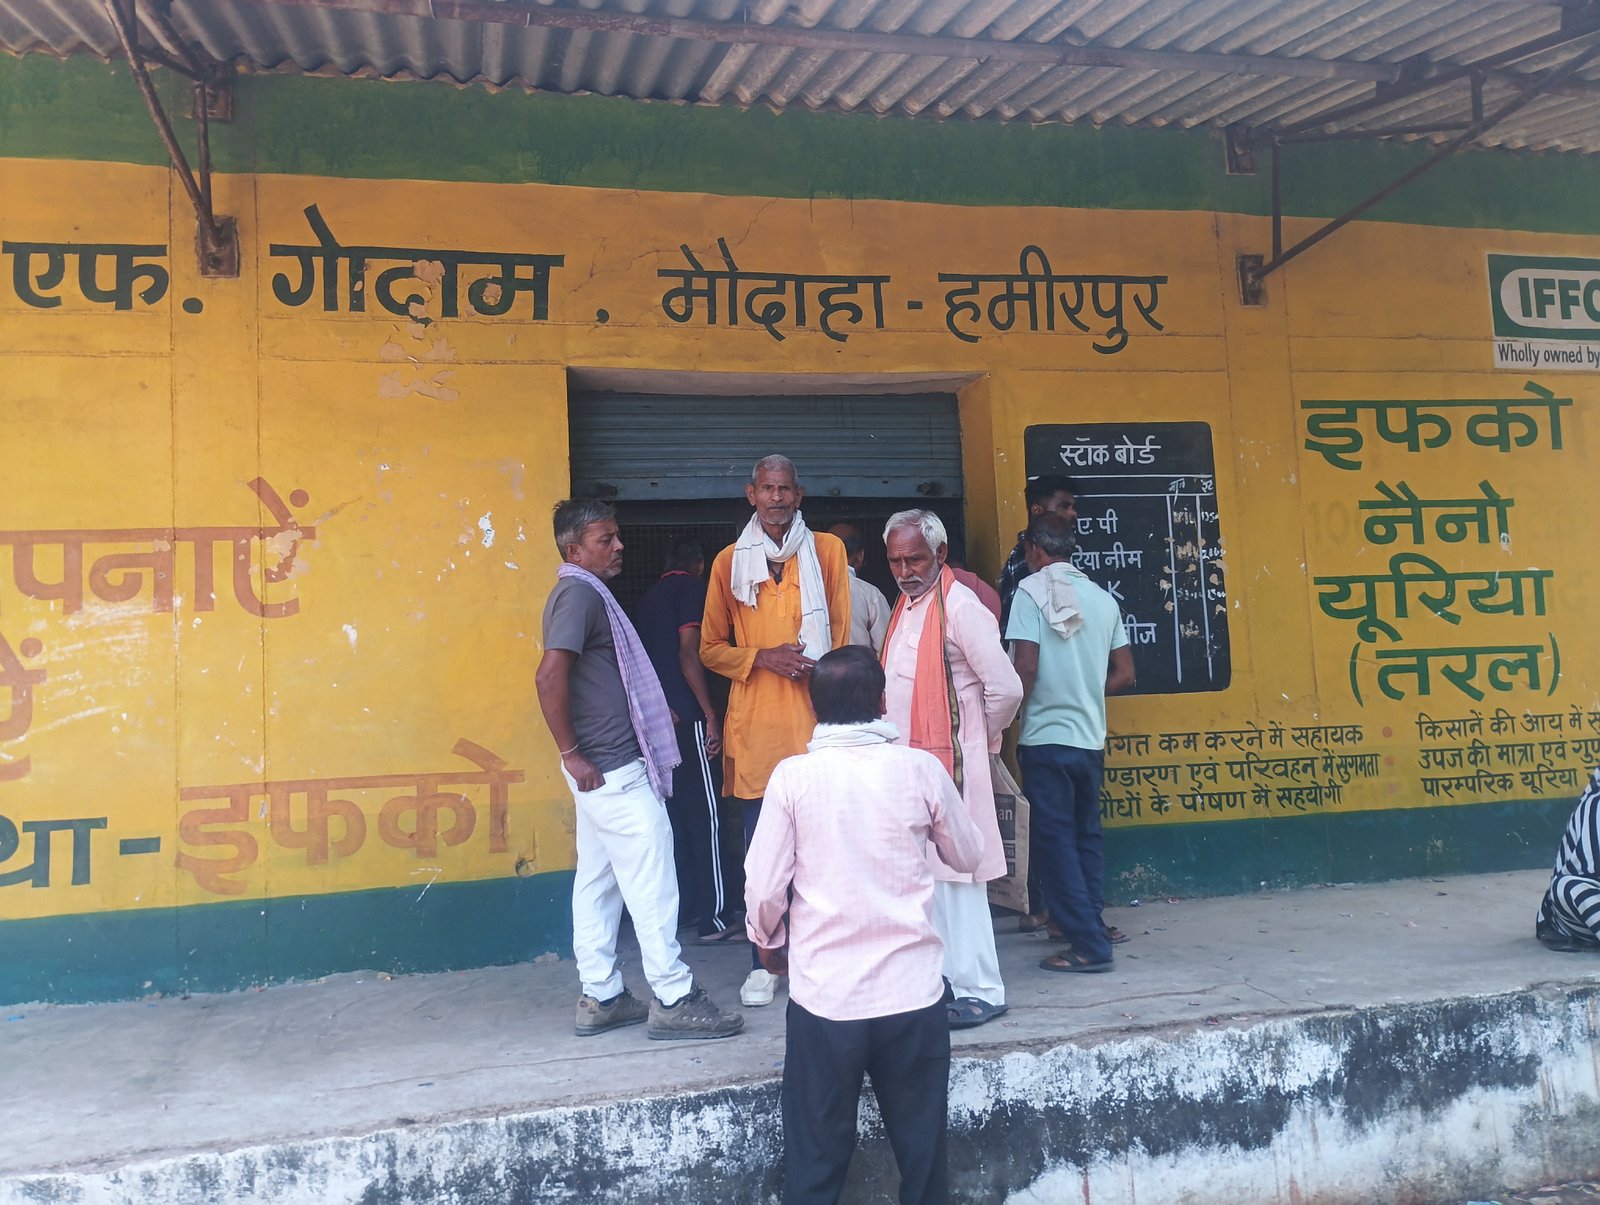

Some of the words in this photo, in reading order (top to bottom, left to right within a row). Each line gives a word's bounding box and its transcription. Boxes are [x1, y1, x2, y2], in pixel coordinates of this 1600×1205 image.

[270, 202, 565, 327] गोदाम
[938, 245, 1168, 354] हमीरपुर
[1498, 342, 1540, 367] Wholly
[1544, 346, 1583, 363] owned
[1587, 346, 1600, 368] by
[1301, 380, 1574, 470] इफको
[1114, 434, 1161, 465] बोर्ड
[1096, 508, 1118, 534] पी
[1359, 480, 1515, 545] नैनो
[1102, 542, 1143, 569] नीम
[1314, 552, 1554, 642] यूरिया
[1350, 632, 1560, 707] (तरल)
[1490, 707, 1516, 735] की
[1520, 713, 1563, 734] आय
[1569, 704, 1583, 730] में
[1105, 735, 1151, 756] ागत
[1158, 732, 1200, 753] कम
[1204, 721, 1265, 751] करने
[1268, 721, 1286, 748] में
[1292, 724, 1364, 751] सहायक
[1418, 748, 1464, 769] उपज
[1467, 738, 1491, 767] की
[1495, 743, 1535, 767] मात्रा
[1539, 733, 1568, 766] एवं
[1103, 765, 1181, 786] ण्डारण
[1185, 756, 1220, 790] एवं
[1225, 752, 1319, 783] परिवहन
[1322, 748, 1336, 778] में
[1337, 753, 1381, 785] सुगमता
[1420, 769, 1515, 798] पारम्परिक
[1519, 763, 1578, 794] यूरिया
[1148, 787, 1171, 815] के
[1177, 787, 1248, 813] पोषण
[1251, 783, 1272, 809] में
[1276, 778, 1343, 811] सहयोगी
[175, 737, 525, 895] इफको
